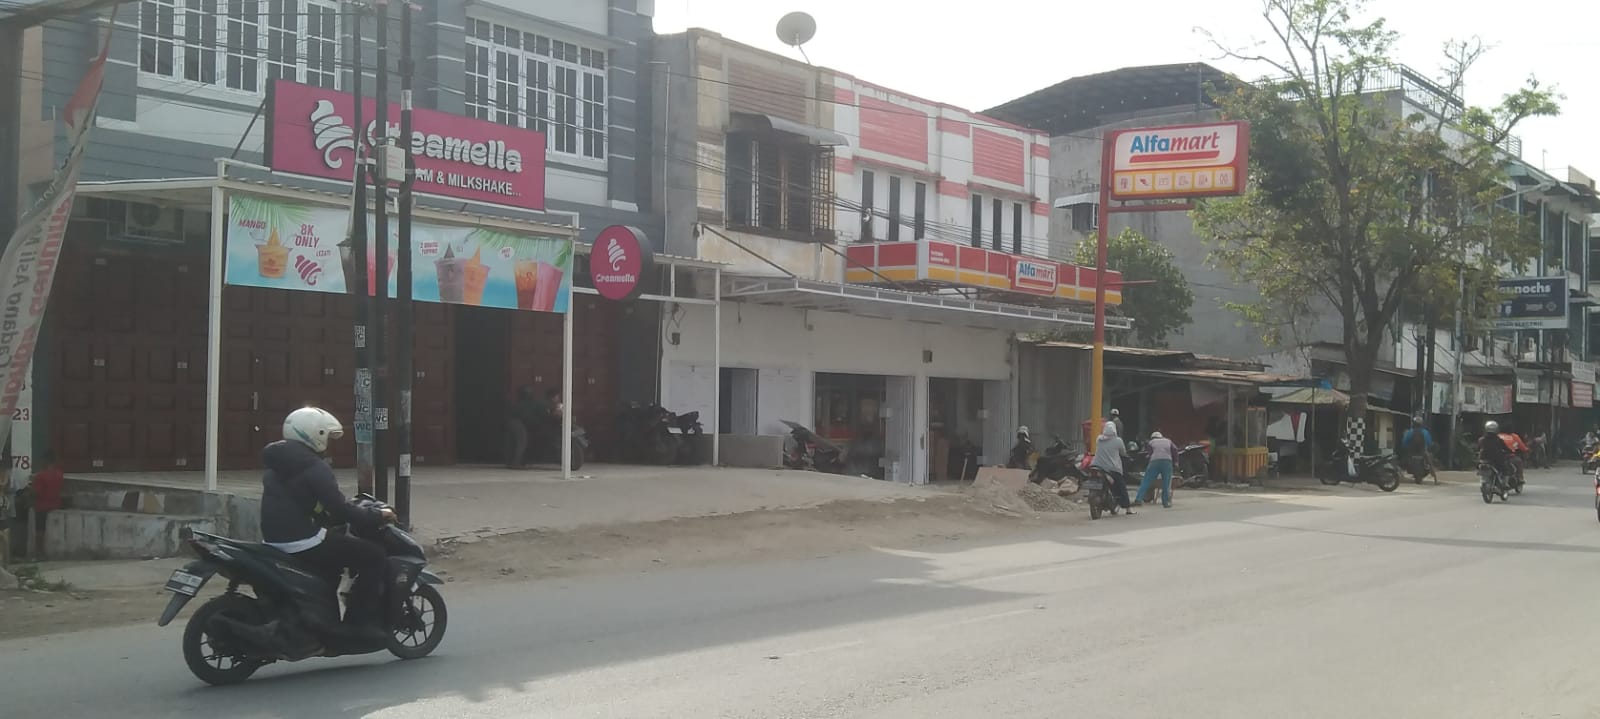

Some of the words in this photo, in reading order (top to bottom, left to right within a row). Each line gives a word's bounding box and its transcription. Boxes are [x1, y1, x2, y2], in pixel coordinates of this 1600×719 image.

[1130, 131, 1220, 153] Alfamart
[436, 171, 445, 184] &
[240, 219, 266, 229] MANGO
[301, 223, 314, 236] 8K
[295, 235, 319, 248] ONLY
[596, 273, 635, 283] Creamella
[1019, 262, 1055, 281] Alfamart
